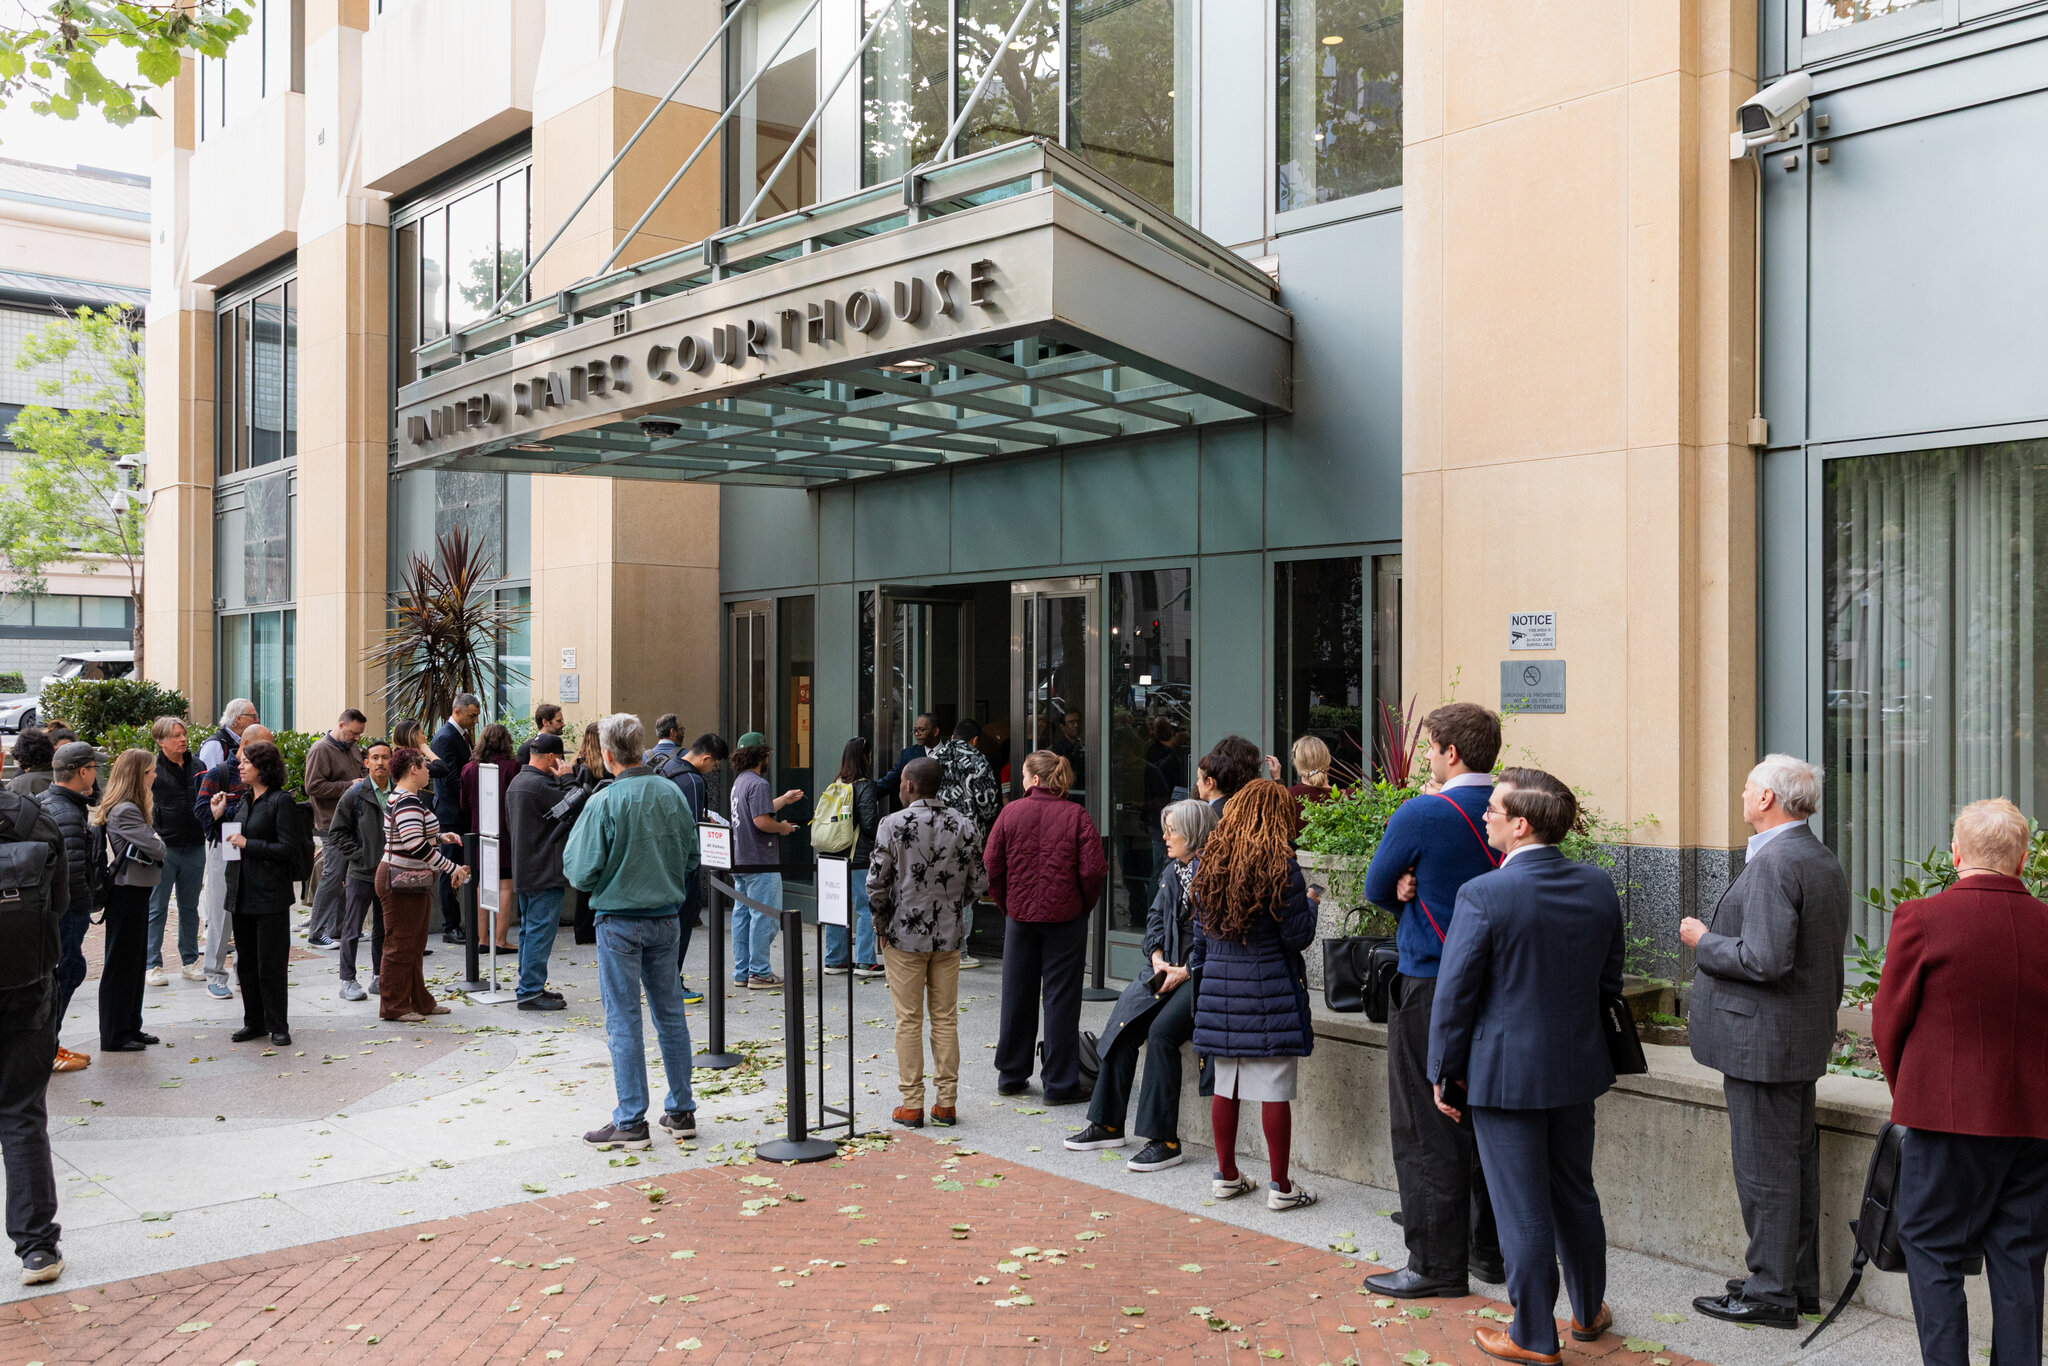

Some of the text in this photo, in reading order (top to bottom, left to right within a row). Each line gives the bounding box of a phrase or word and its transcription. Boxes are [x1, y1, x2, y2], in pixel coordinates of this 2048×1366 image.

[408, 258, 994, 446] UNITED STATES COURTHOUSE
[1512, 615, 1552, 626] NOTICE
[708, 831, 723, 839] STOP
[825, 880, 841, 889] PUBLIC
[826, 892, 840, 900] ENTRY
